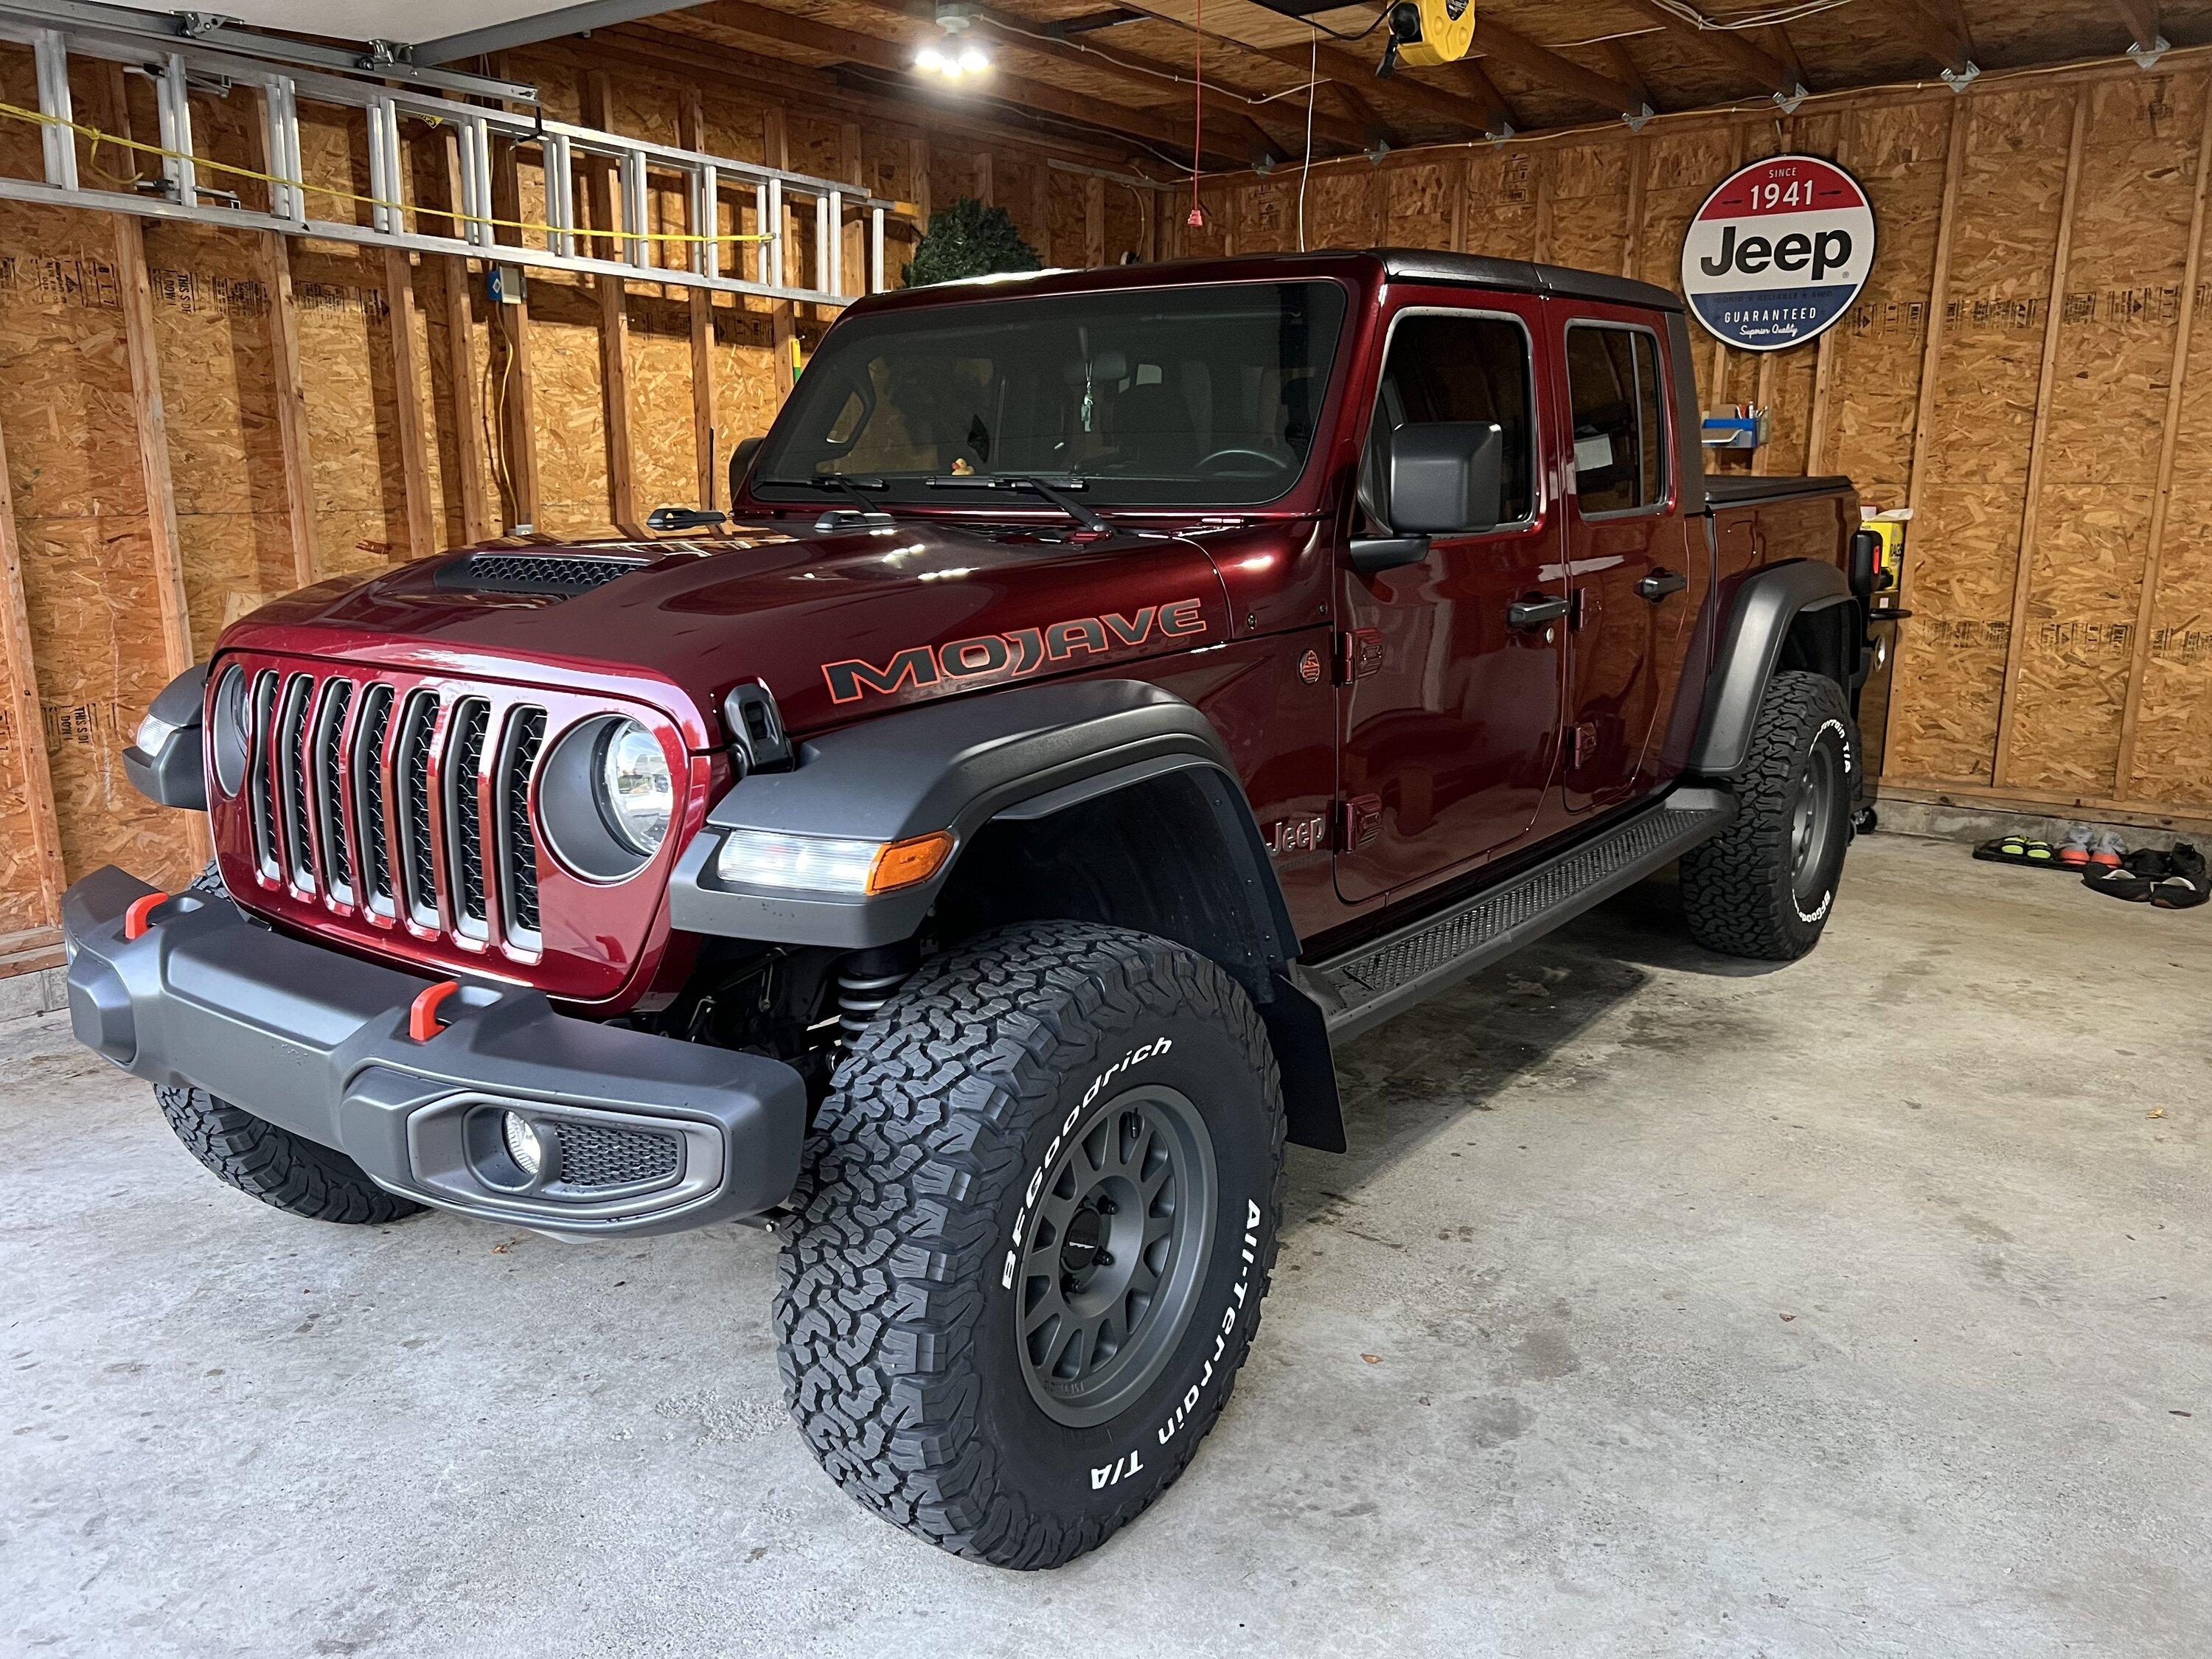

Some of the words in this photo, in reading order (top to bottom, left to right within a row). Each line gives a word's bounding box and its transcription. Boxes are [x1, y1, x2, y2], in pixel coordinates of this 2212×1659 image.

[1769, 167, 1797, 178] SINCE
[1750, 180, 1813, 210] 1941
[1700, 226, 1852, 281] Jeep
[1724, 307, 1816, 324] GUARANTEED
[1739, 324, 1770, 339] Superior
[1772, 323, 1798, 337] Quality
[821, 598, 1207, 704] MOJAVE
[1265, 817, 1326, 857] Jeep
[1002, 1037, 1172, 1290] BFGoodrich
[1158, 1198, 1262, 1445] All-Terrain
[1091, 1449, 1144, 1490] T/A
